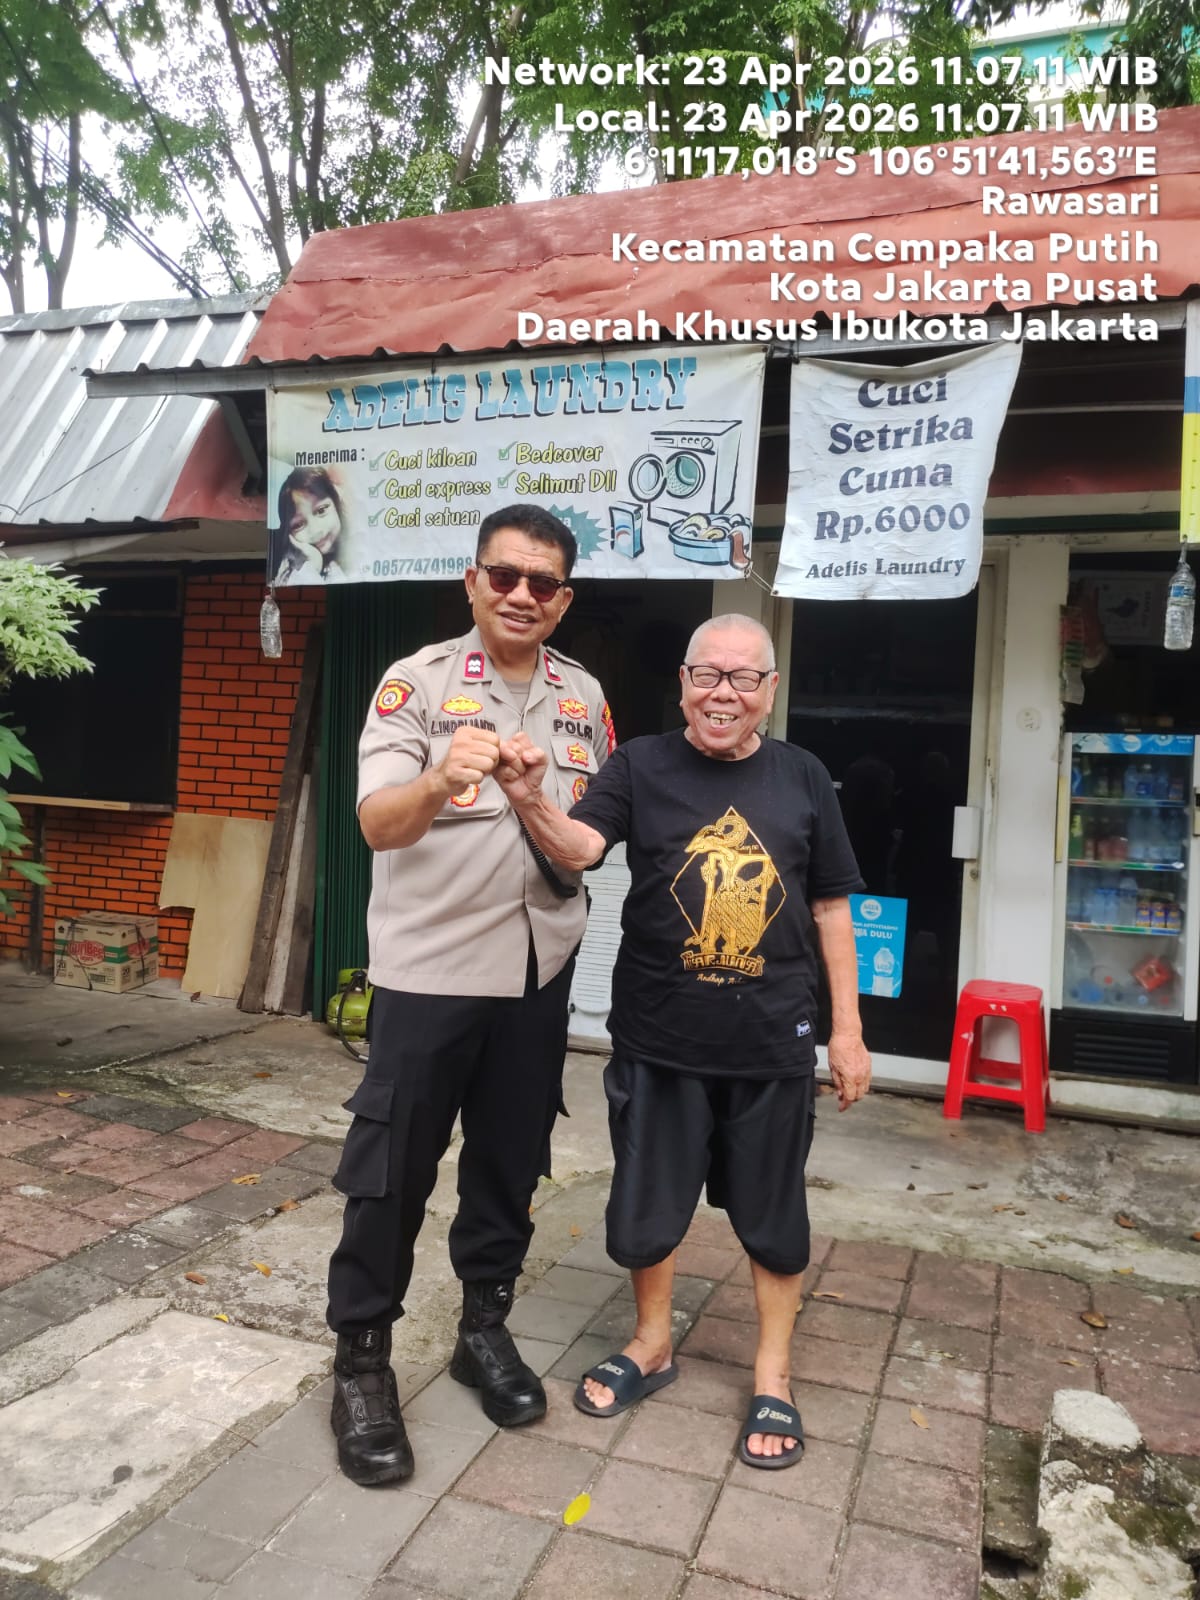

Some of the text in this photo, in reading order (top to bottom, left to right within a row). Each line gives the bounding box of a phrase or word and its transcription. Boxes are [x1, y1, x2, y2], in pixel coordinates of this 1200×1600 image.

[322, 357, 697, 433] ADELIS LAUNDRY
[857, 373, 948, 409] Cuci
[827, 414, 974, 454] Setrika
[384, 447, 477, 470] Cuci kiloan
[516, 441, 603, 465] Bedcover
[384, 478, 491, 502] Cuci express
[515, 472, 586, 495] Selimut
[839, 462, 952, 496] Cuma
[384, 507, 480, 528] Cuci satuan
[814, 502, 971, 544] Rp.6000
[805, 556, 967, 579] Adelis Laundry
[553, 718, 593, 741] POLRI
